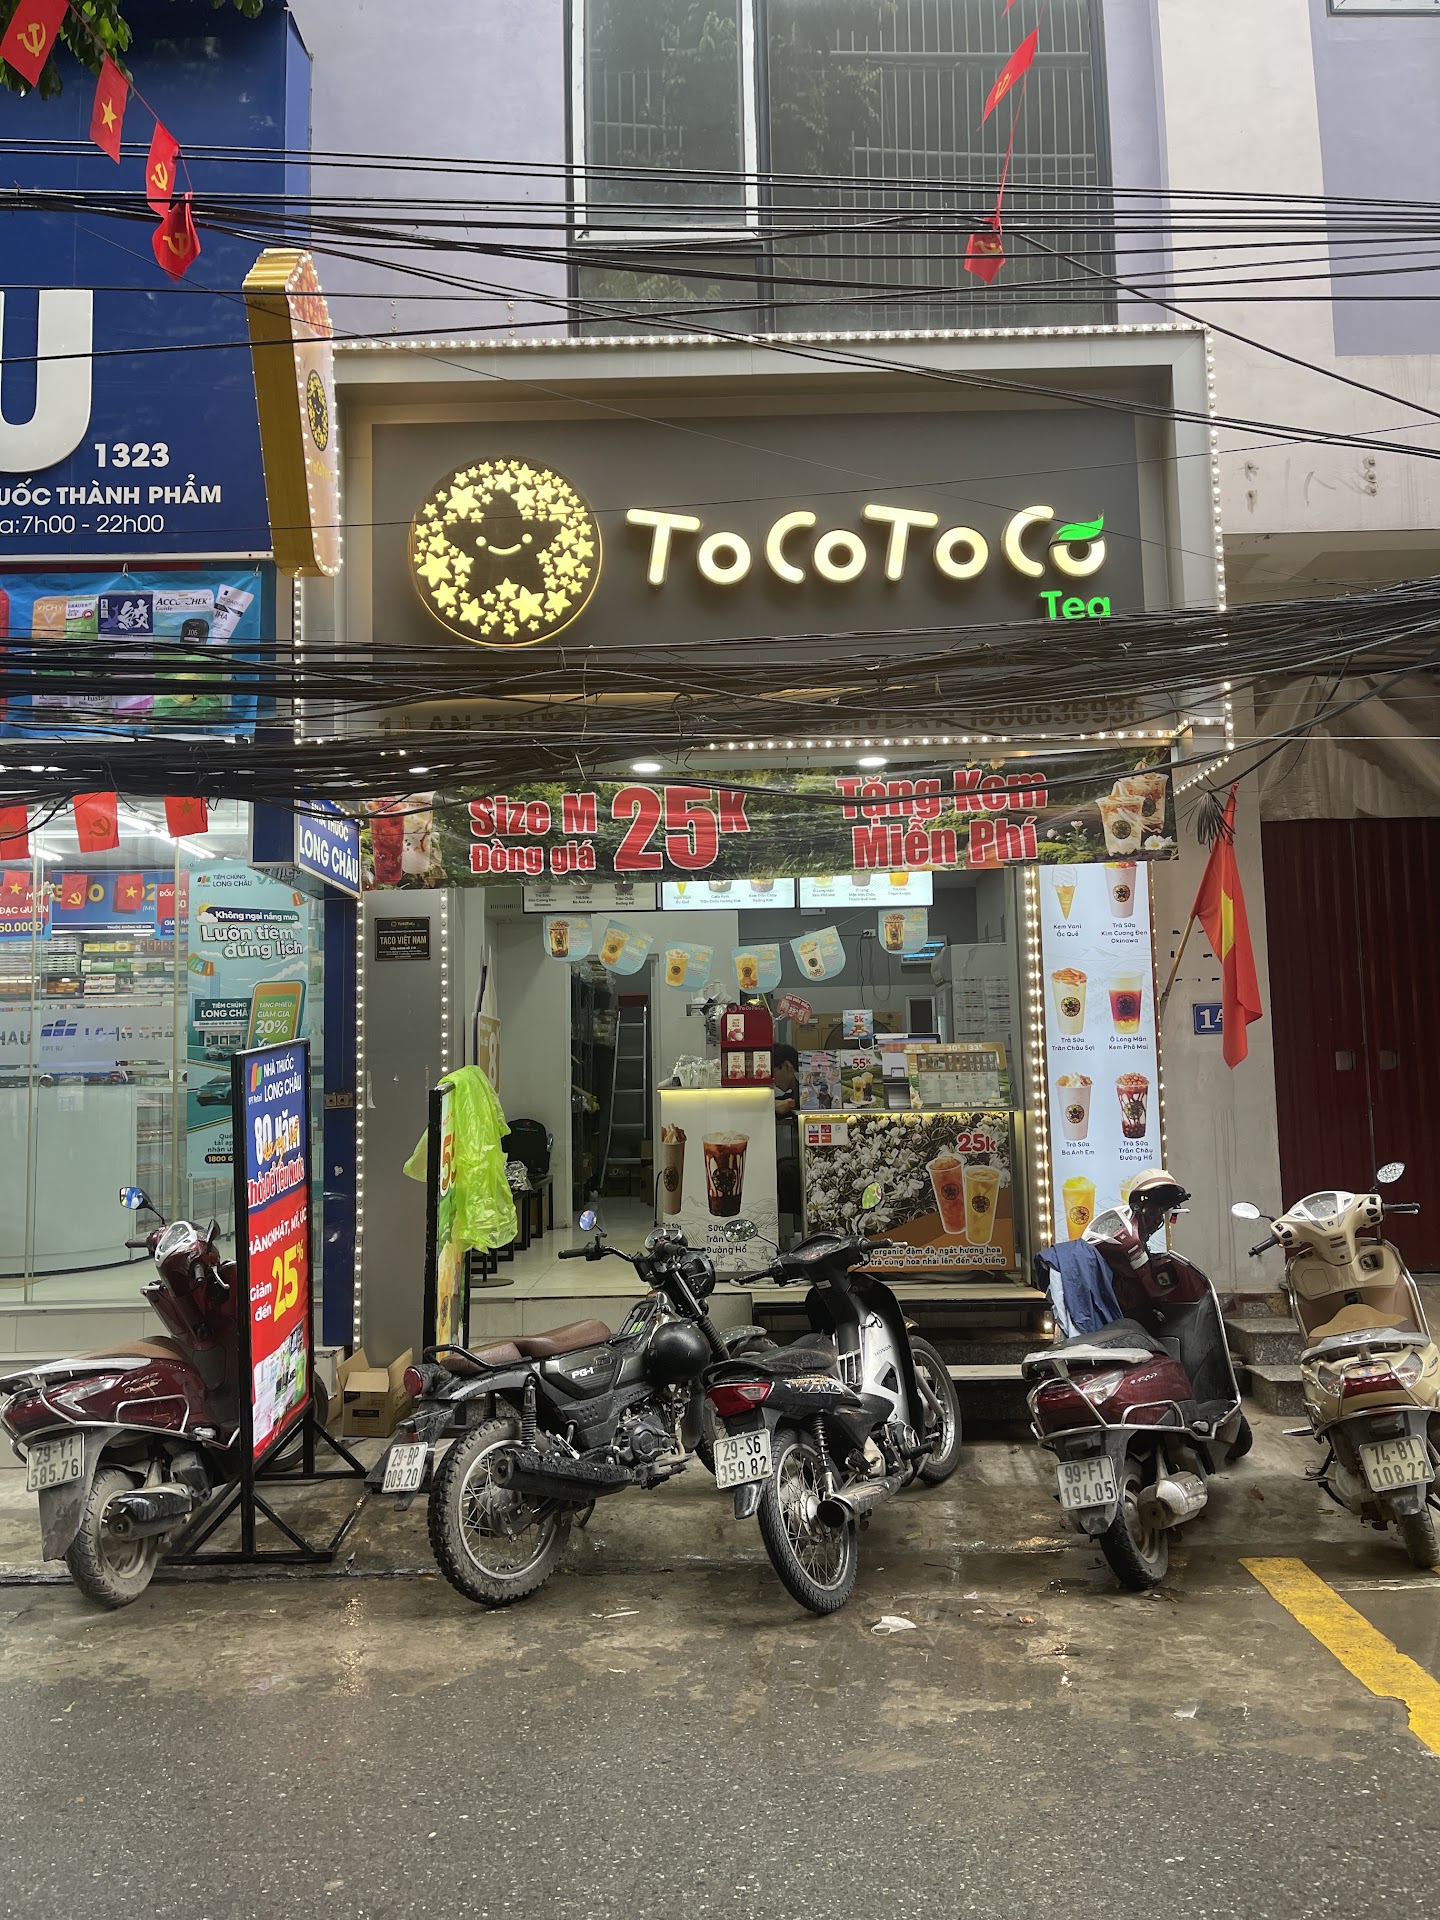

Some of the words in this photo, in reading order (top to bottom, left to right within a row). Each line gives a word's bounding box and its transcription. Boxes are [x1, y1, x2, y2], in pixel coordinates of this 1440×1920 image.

[95, 442, 170, 468] 1323
[56, 479, 140, 505] THÀNH
[148, 477, 221, 504] PHẨM
[96, 515, 164, 533] 22h00
[1039, 590, 1110, 620] Tea
[833, 775, 943, 825] Tặng
[952, 769, 1049, 814] Kem
[469, 794, 552, 838] Size
[561, 792, 598, 835] M
[299, 824, 330, 868] LONG
[330, 847, 359, 884] CHÂU
[851, 817, 959, 870] Miễn
[970, 815, 1039, 863] Phí
[469, 838, 544, 876] Đồng
[549, 840, 598, 875] giá
[233, 879, 253, 887] CHÂU
[215, 910, 244, 921] Không
[245, 911, 263, 922] ngại
[282, 913, 299, 921] mưa
[200, 924, 253, 942] Luôn
[256, 923, 294, 941] tiêm
[380, 936, 396, 946] TACO
[223, 942, 273, 960] đúng
[275, 940, 304, 959] lịch
[201, 1009, 228, 1018] LONG
[255, 1019, 289, 1034] 20%
[263, 1058, 276, 1078] NHÀ
[276, 1052, 295, 1075] THUỐC
[264, 1080, 284, 1103] LONG
[284, 1071, 302, 1096] CHÂU
[254, 1112, 274, 1166] 80
[956, 1132, 999, 1153] 25k
[1119, 1154, 1142, 1162] Đường
[874, 1248, 904, 1257] organic
[905, 1246, 923, 1257] đậm
[986, 1246, 1002, 1254] hoa
[884, 1258, 904, 1268] cùng
[955, 1256, 970, 1264] đến
[984, 1256, 1006, 1266] tiếng
[250, 1281, 273, 1302] Giảm
[255, 1302, 273, 1322] đến
[722, 1435, 761, 1462] 29-S6
[30, 1458, 79, 1488] 585.76
[385, 1468, 419, 1489] 009.20
[720, 1455, 768, 1485] 359.82
[1064, 1460, 1104, 1484] 99-F1
[1372, 1460, 1431, 1488] 108.22
[1064, 1480, 1114, 1506] 194.05
